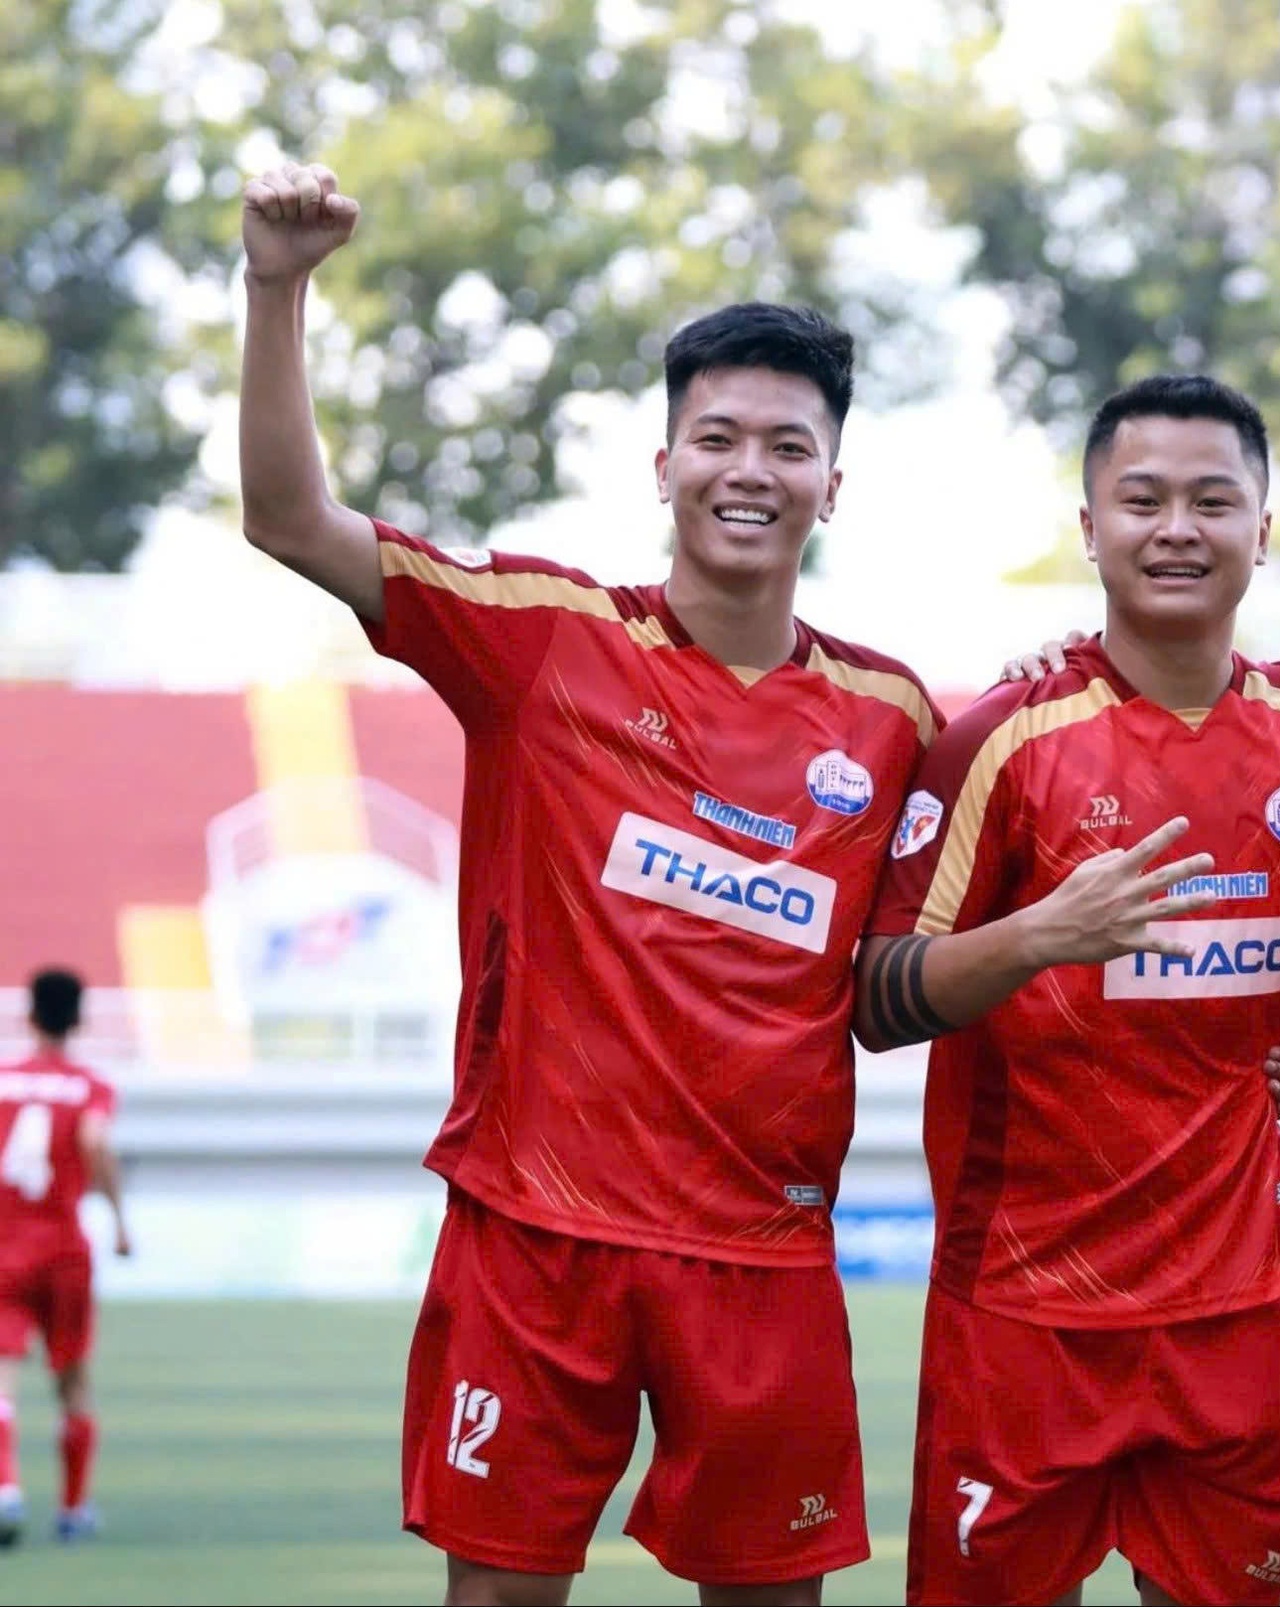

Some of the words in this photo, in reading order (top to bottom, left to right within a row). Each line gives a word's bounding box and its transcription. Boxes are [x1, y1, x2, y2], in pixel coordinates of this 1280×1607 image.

[634, 838, 815, 926] THACO
[0, 1101, 54, 1202] 4
[446, 1379, 501, 1480] 12
[956, 1475, 995, 1558] 7
